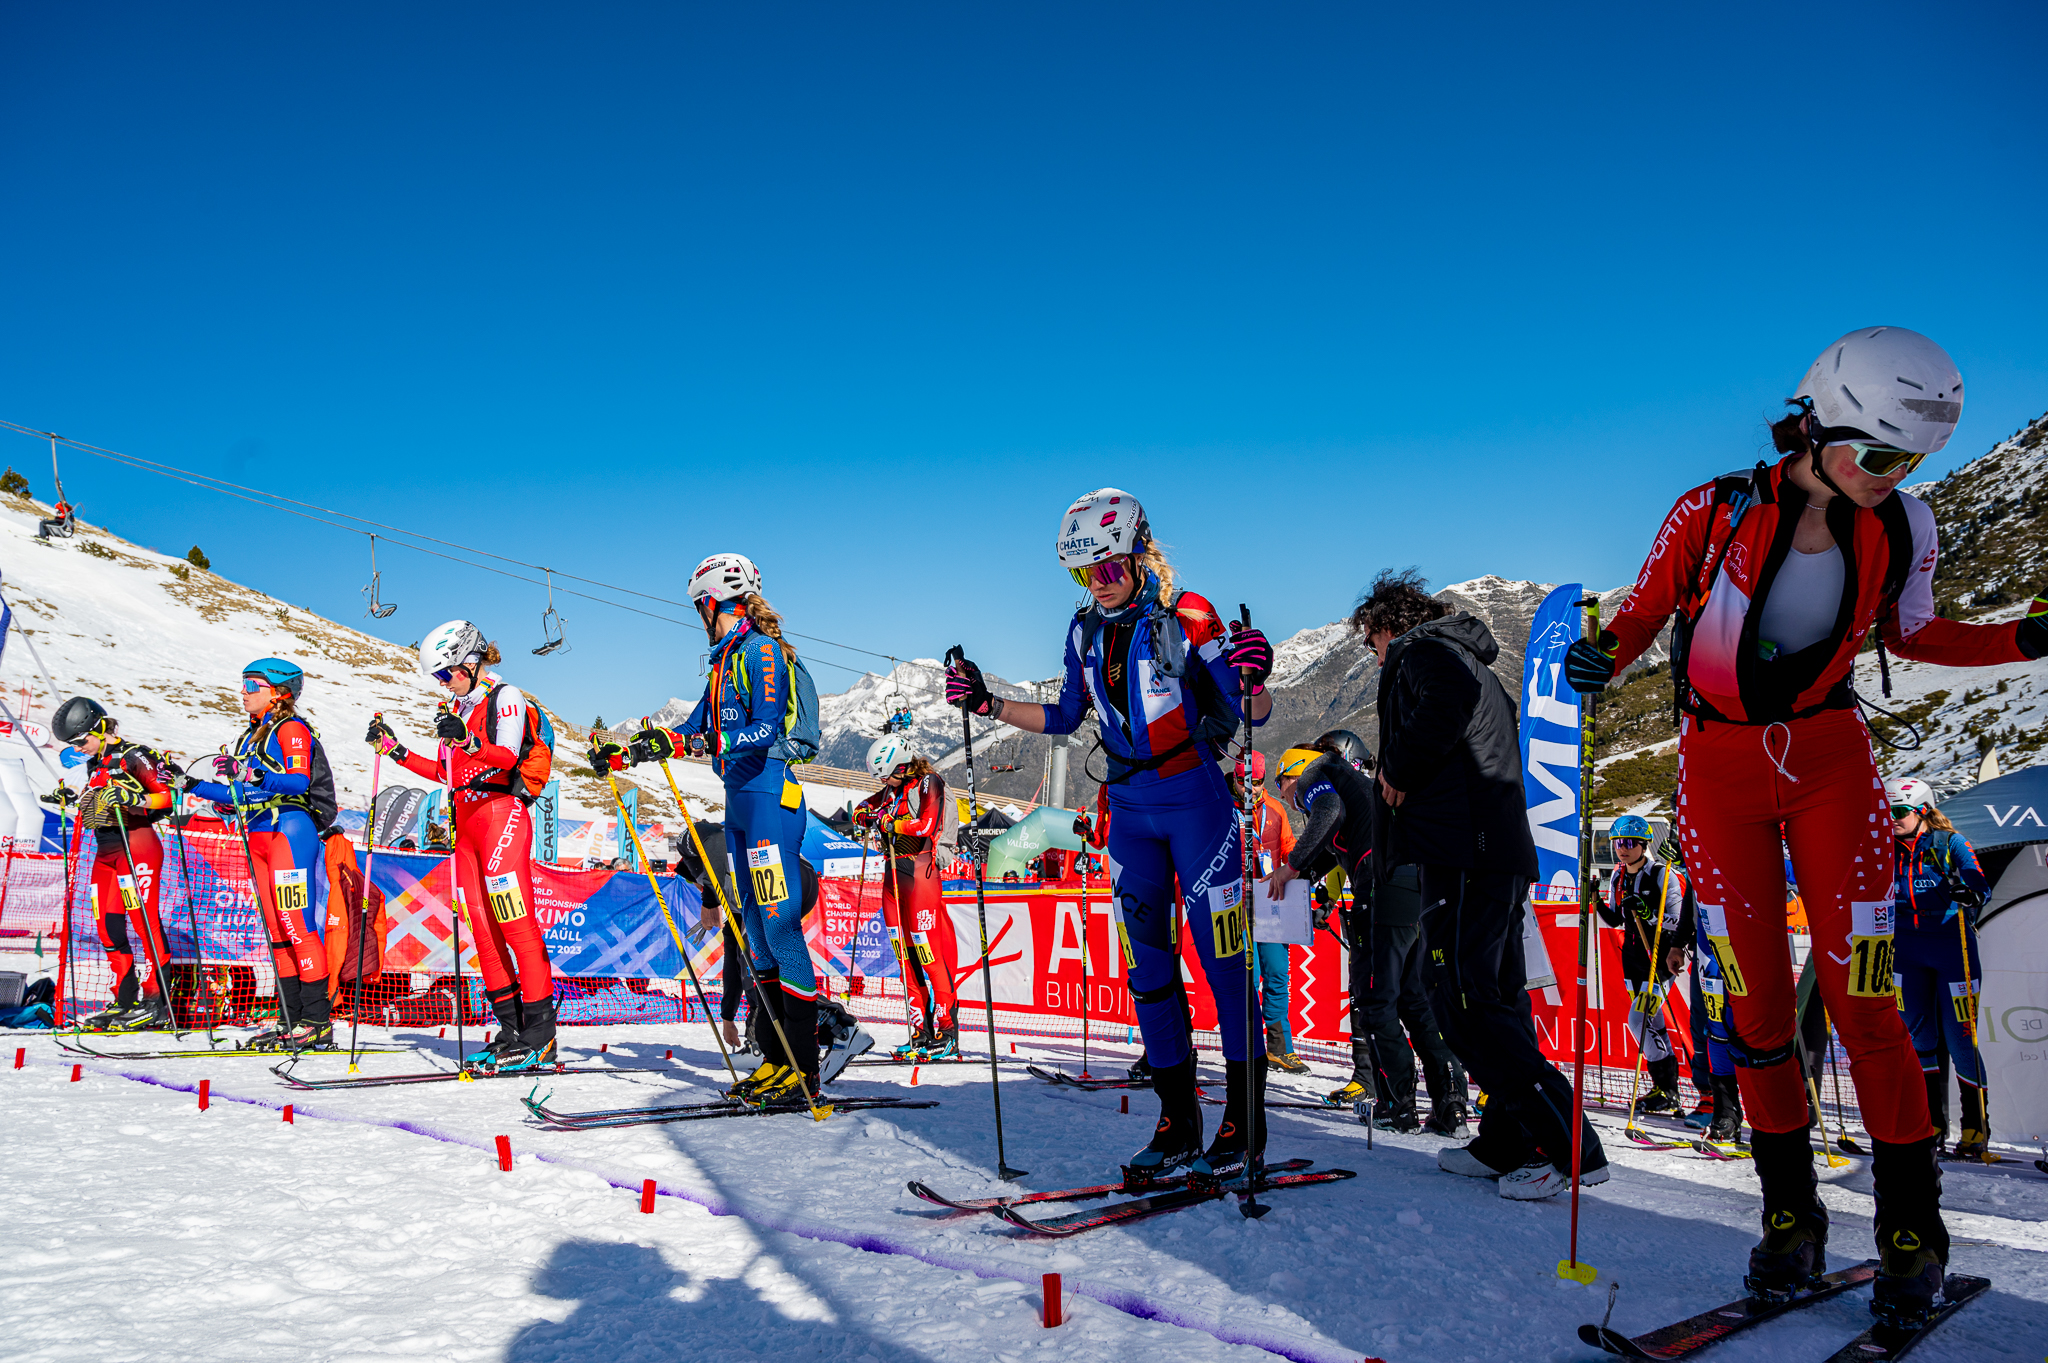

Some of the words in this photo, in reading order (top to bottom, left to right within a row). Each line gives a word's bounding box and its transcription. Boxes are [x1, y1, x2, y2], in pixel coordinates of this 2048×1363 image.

[1060, 537, 1098, 551] CHÂTEL
[760, 644, 776, 702] ITALIA
[1583, 715, 1596, 768] LEKI
[1306, 784, 1331, 804] ISMF
[1007, 838, 1022, 848] VALL
[135, 862, 153, 904] ESP
[276, 885, 307, 909] 105.1
[490, 891, 526, 922] 101.1
[825, 901, 851, 910] WORLD
[825, 910, 881, 919] CHAMPIONSHIPS
[281, 909, 300, 940] Ando
[826, 918, 881, 934] SKIMO
[543, 927, 582, 942] TAÜLL
[826, 935, 846, 946] BOÍ
[849, 935, 881, 947] TAÜLL
[557, 945, 582, 955] 2023
[861, 950, 881, 958] 2023
[497, 1054, 525, 1064] SCARPA
[1355, 1102, 1367, 1115] 10
[1213, 1162, 1244, 1176] SCARPA
